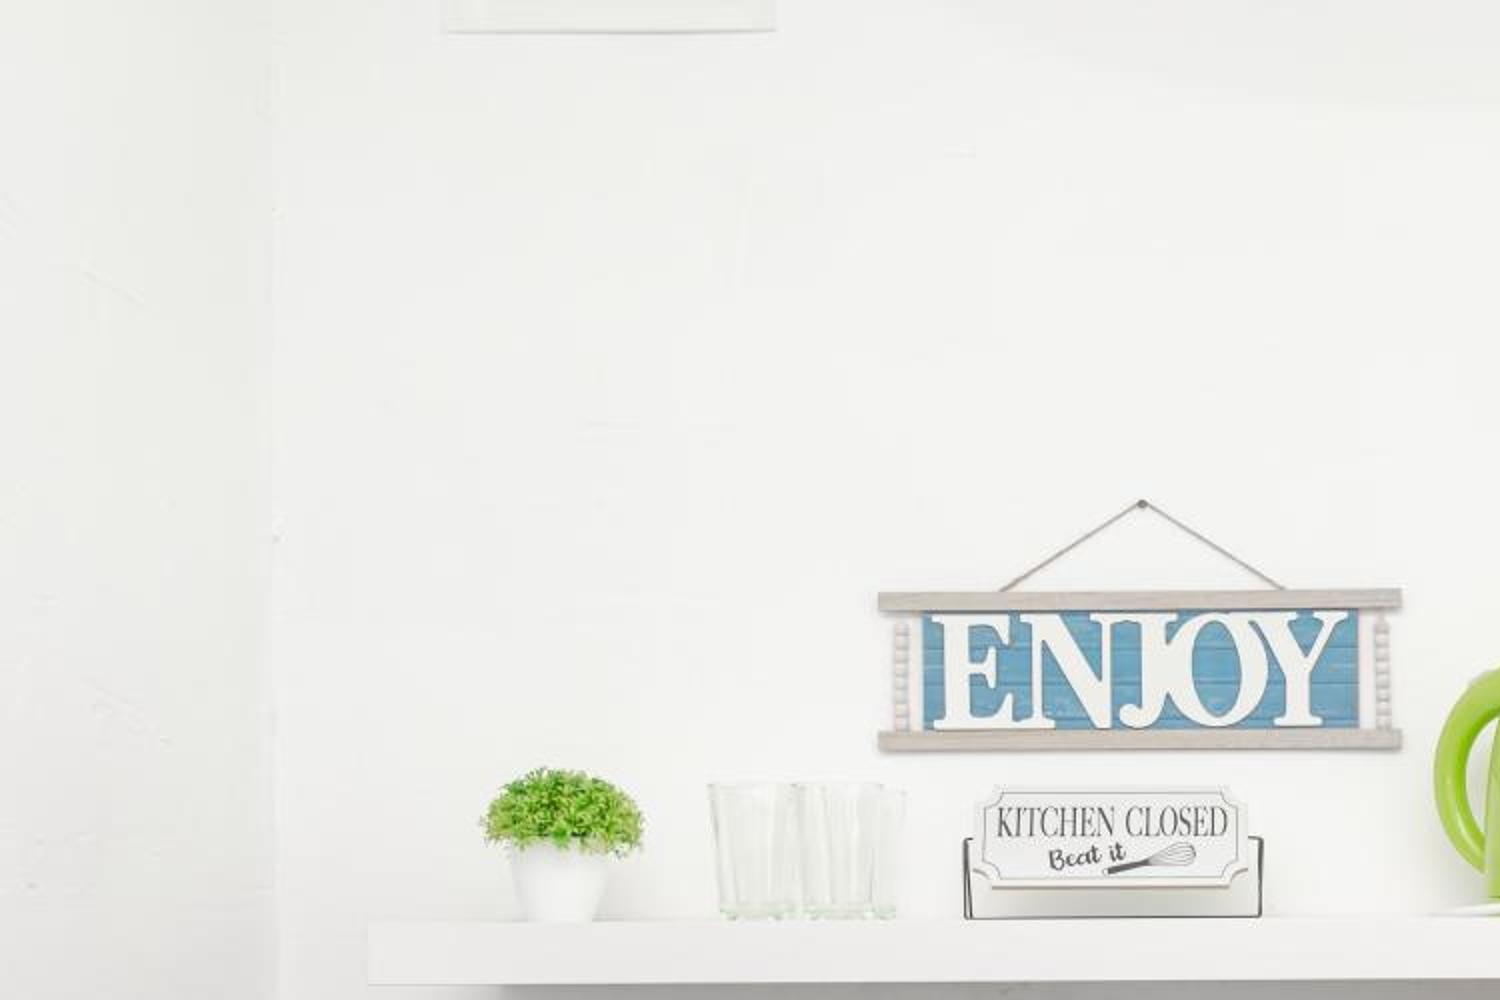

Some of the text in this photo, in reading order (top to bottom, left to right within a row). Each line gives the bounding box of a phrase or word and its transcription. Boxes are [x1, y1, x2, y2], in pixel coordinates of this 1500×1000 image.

[930, 611, 1348, 729] ENJOY
[997, 805, 1228, 838] KITCHEN CLOSED
[1049, 841, 1127, 871] Beat it
